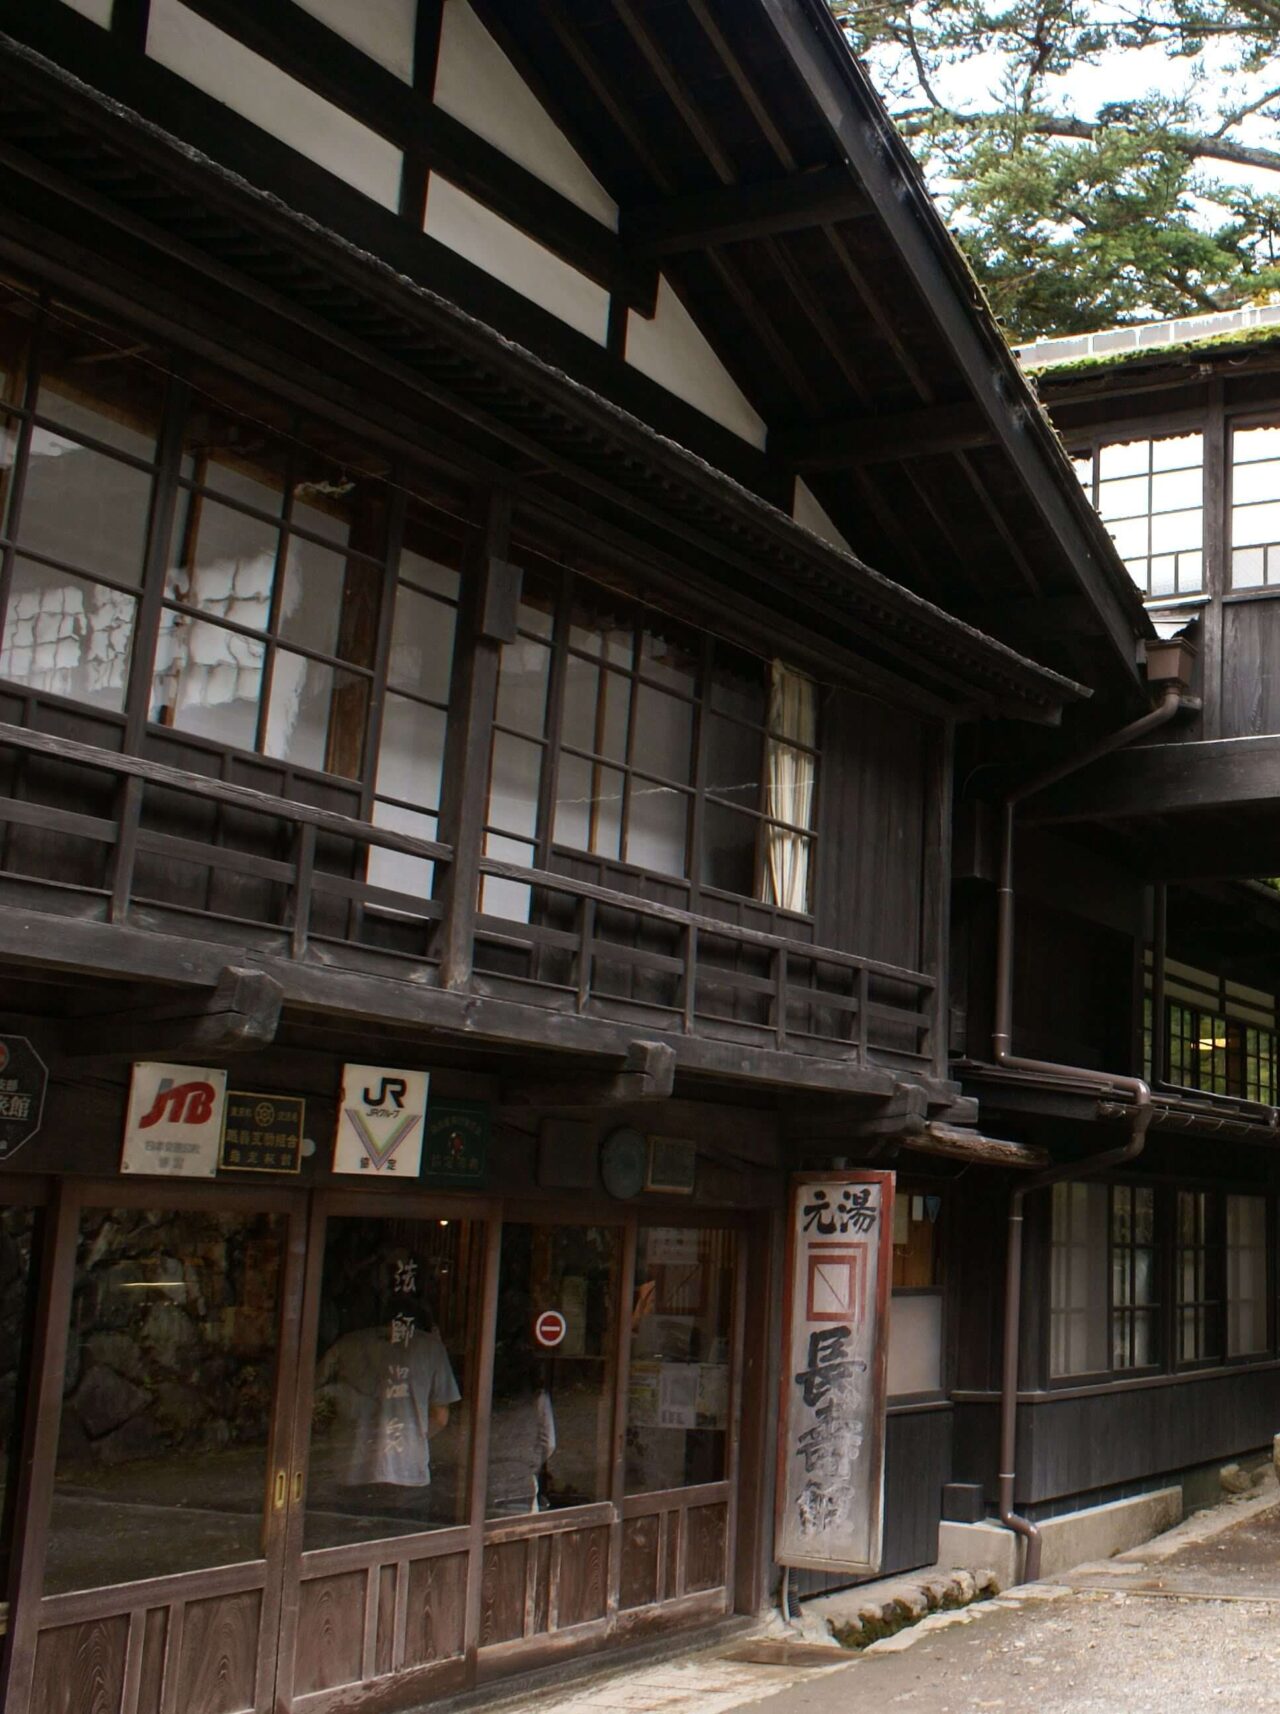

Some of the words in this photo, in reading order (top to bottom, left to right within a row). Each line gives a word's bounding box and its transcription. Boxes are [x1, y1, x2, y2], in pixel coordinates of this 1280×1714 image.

[139, 1078, 216, 1128] JTB
[363, 1077, 407, 1108] JR
[803, 1188, 878, 1234] 元湯
[382, 1258, 418, 1454] 法師温泉
